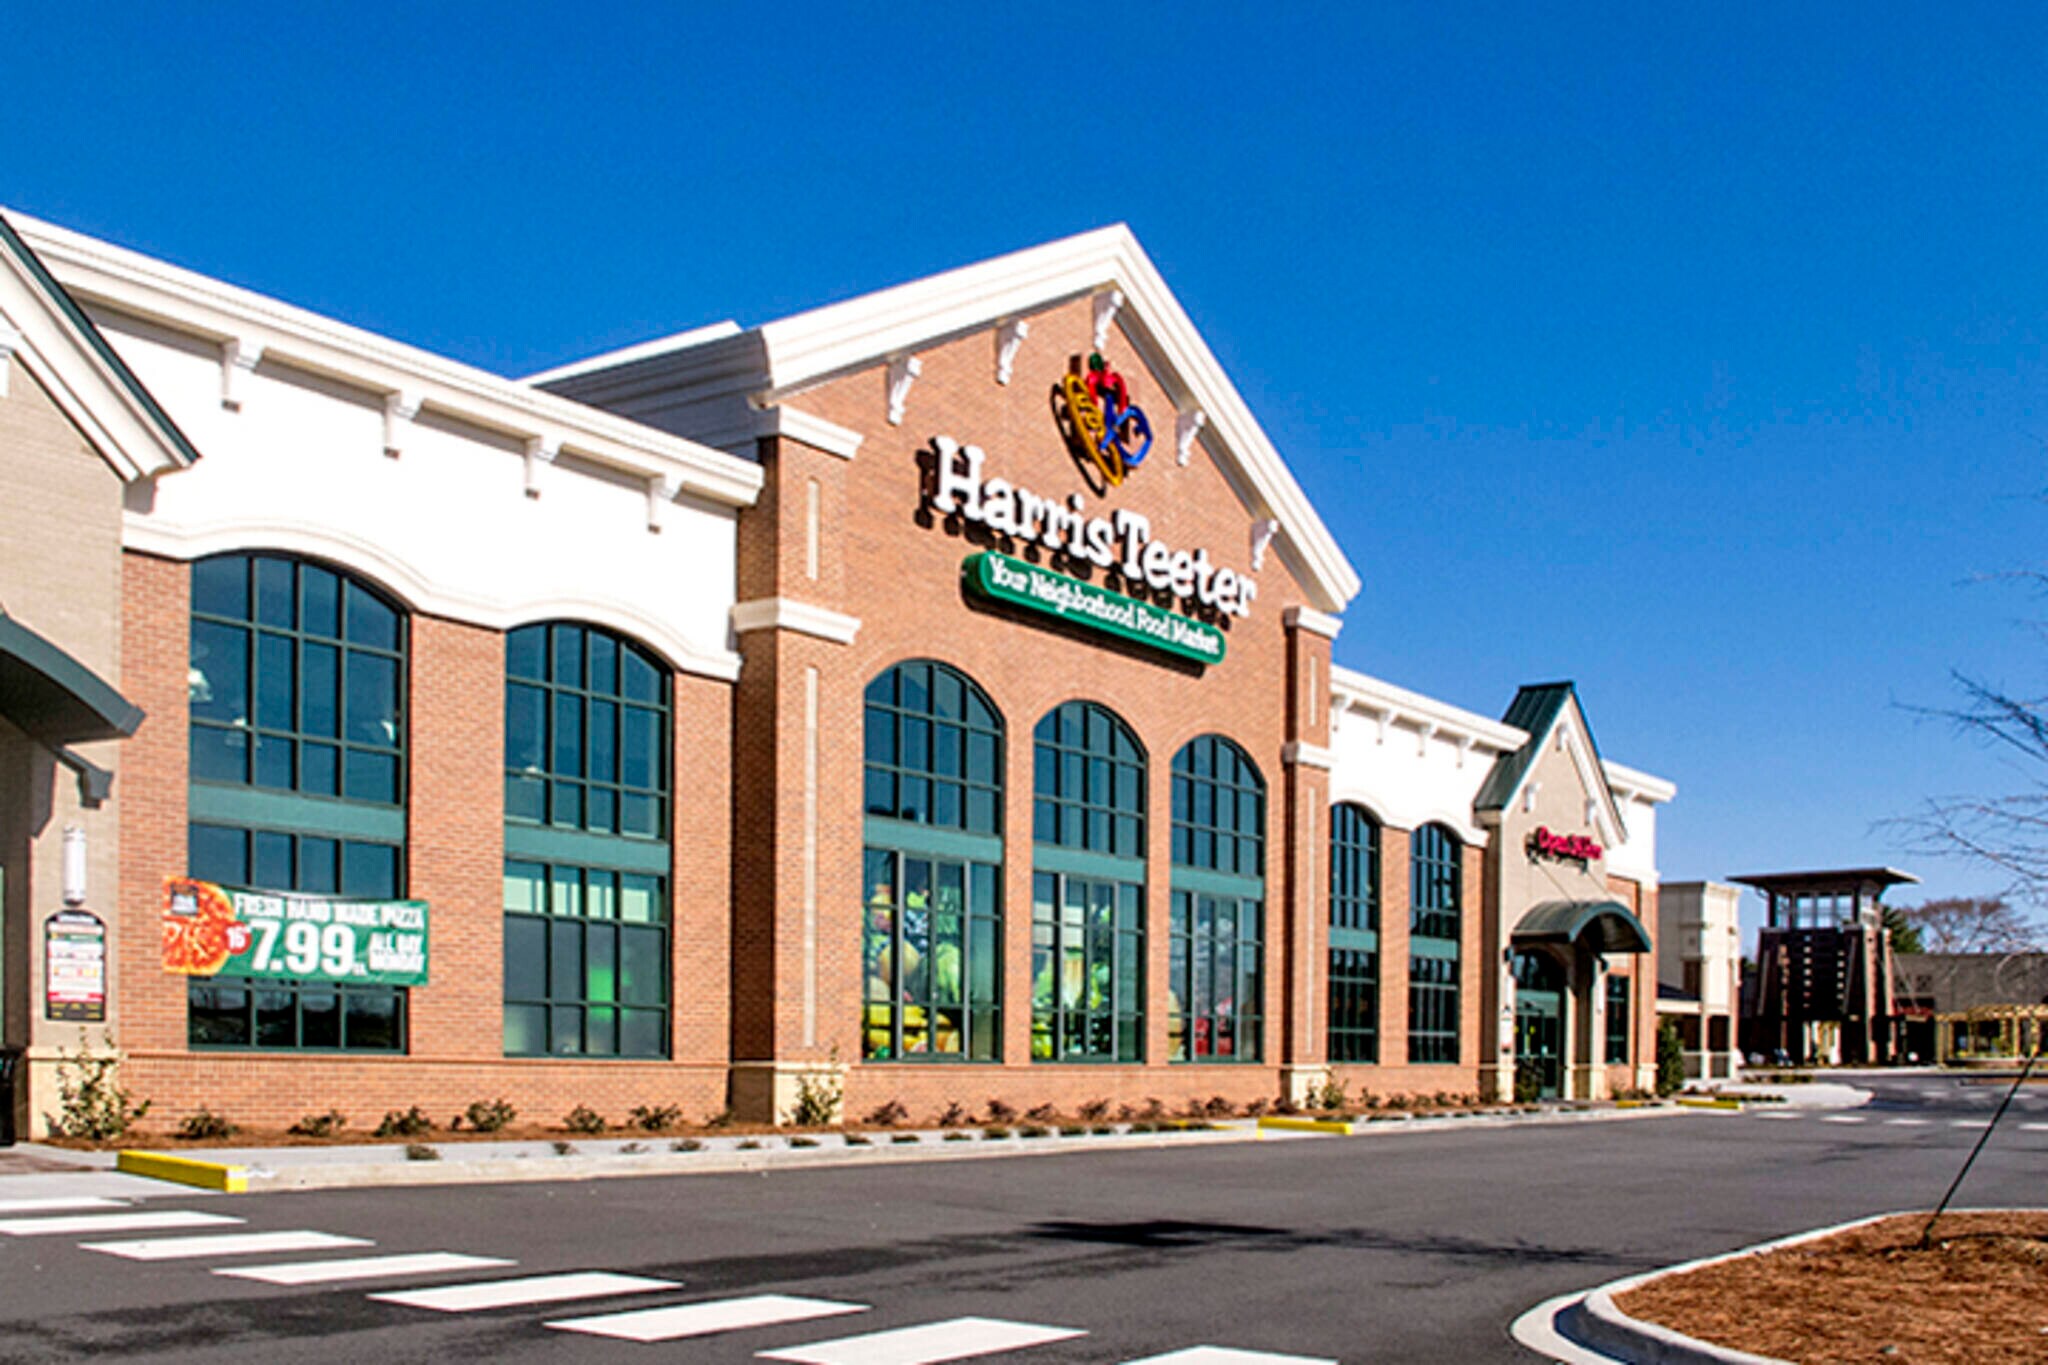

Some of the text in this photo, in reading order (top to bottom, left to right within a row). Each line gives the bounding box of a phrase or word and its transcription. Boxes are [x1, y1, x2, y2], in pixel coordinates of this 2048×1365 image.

[934, 436, 1257, 617] Harris Teeter
[989, 554, 1219, 655] Your Neighborhood Food Market
[249, 918, 356, 976] 7.99
